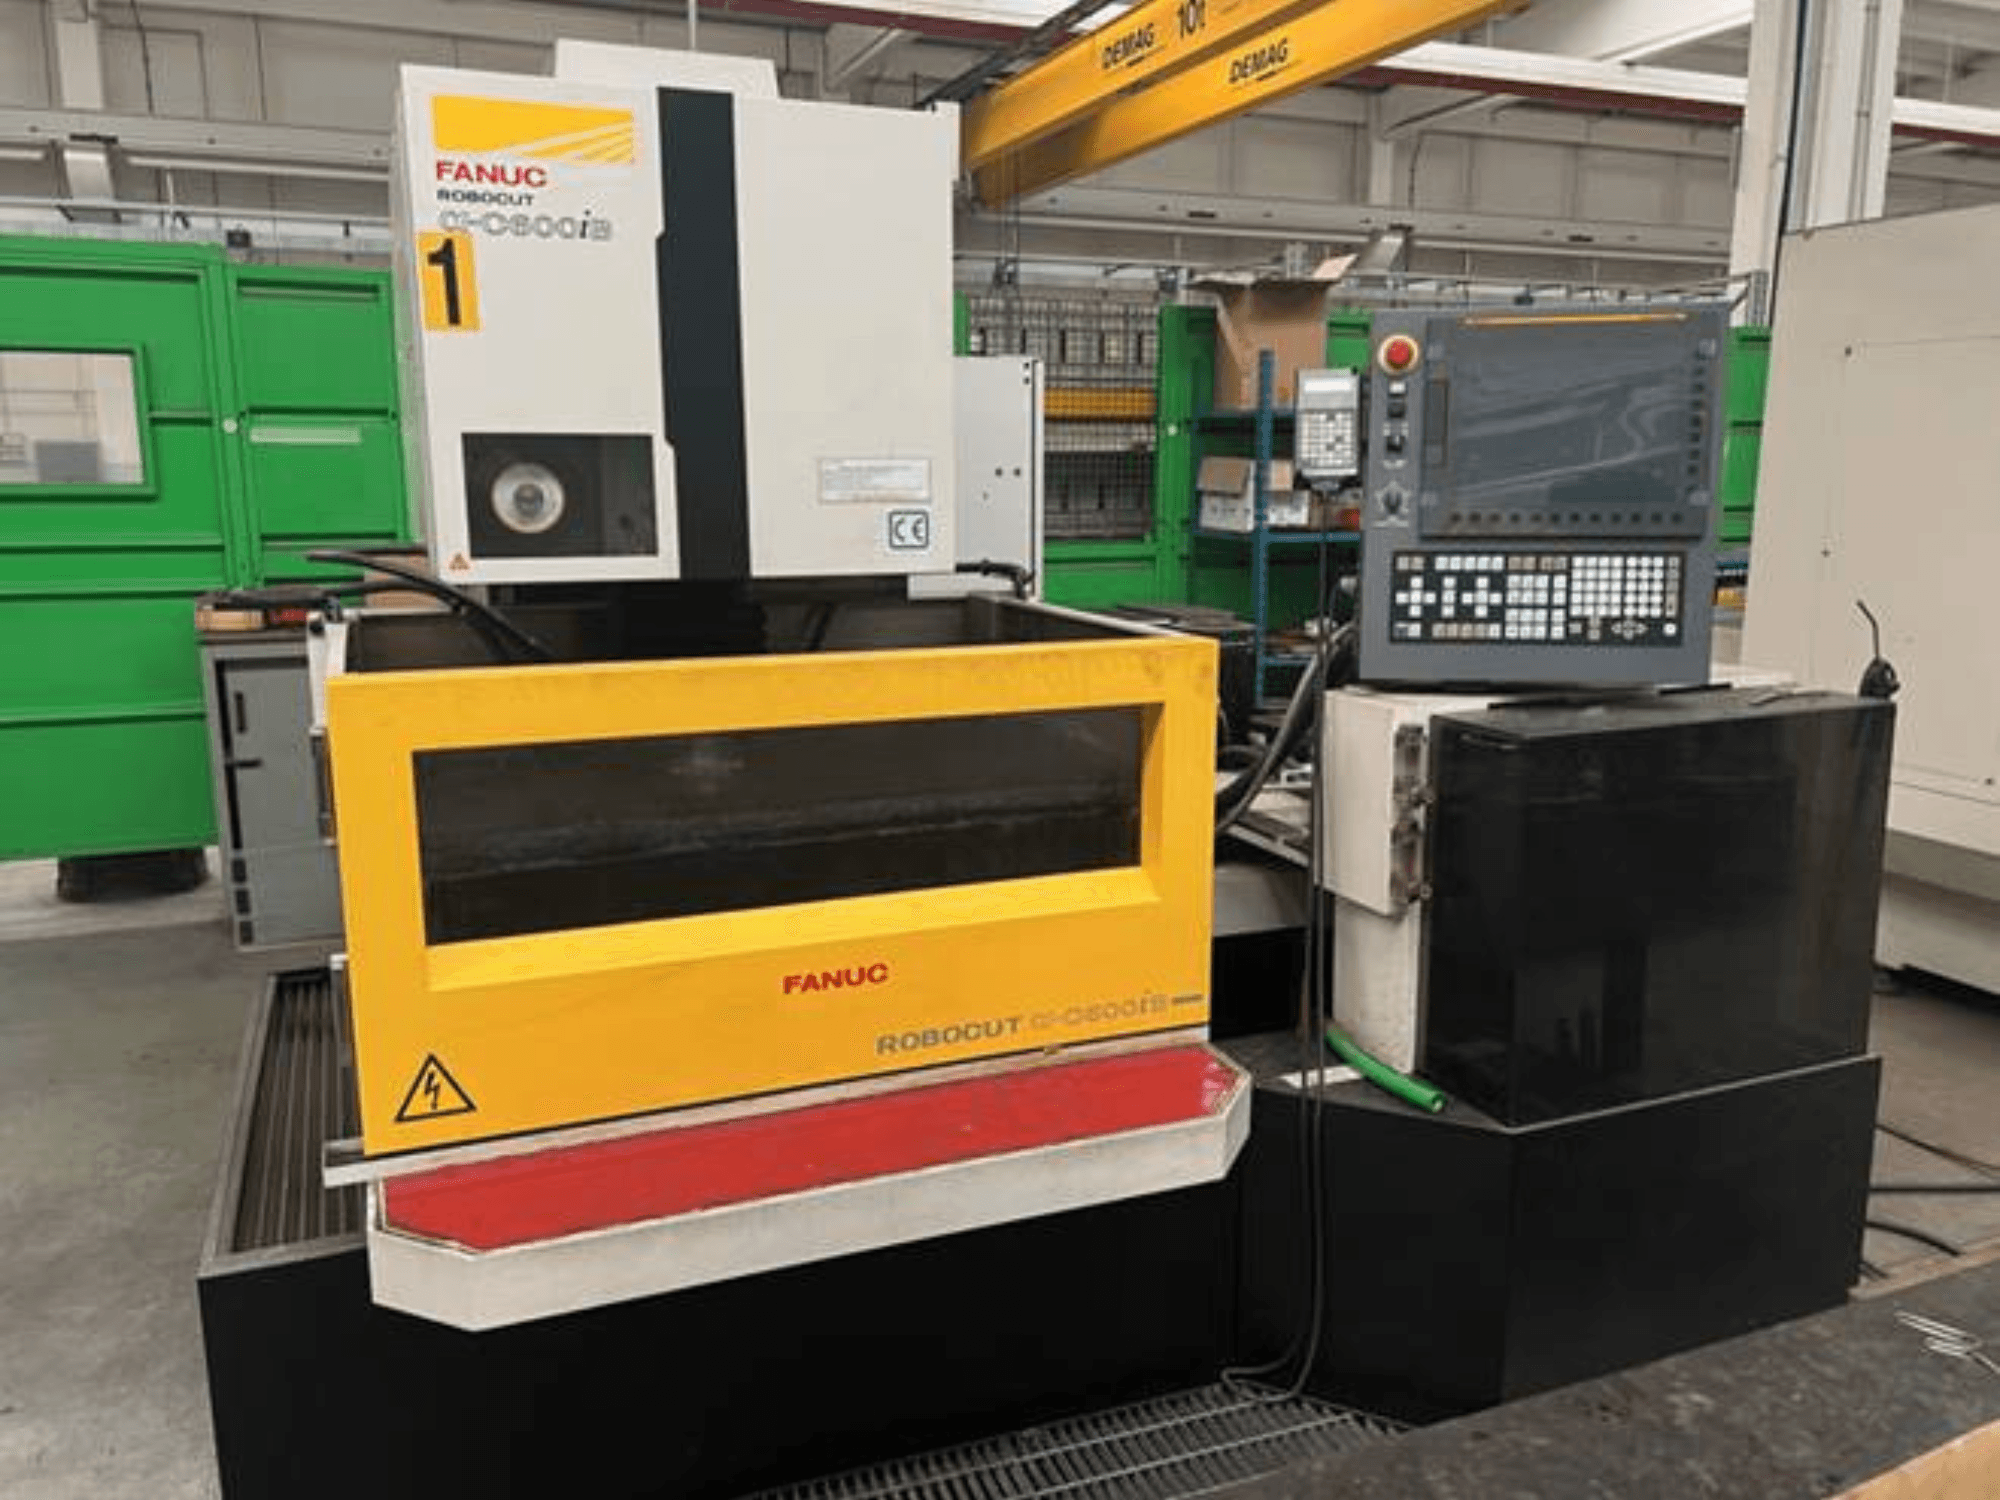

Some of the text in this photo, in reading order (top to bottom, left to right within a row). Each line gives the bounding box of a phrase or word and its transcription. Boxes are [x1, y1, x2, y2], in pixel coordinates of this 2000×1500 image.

[1101, 22, 1155, 70] DEMAG
[1228, 37, 1289, 84] DEMAG
[435, 160, 547, 188] FANUC
[436, 188, 535, 206] ROBOCUT
[427, 237, 462, 326] 1
[783, 962, 889, 995] FANUC
[876, 1014, 1025, 1056] ROBOCUT
